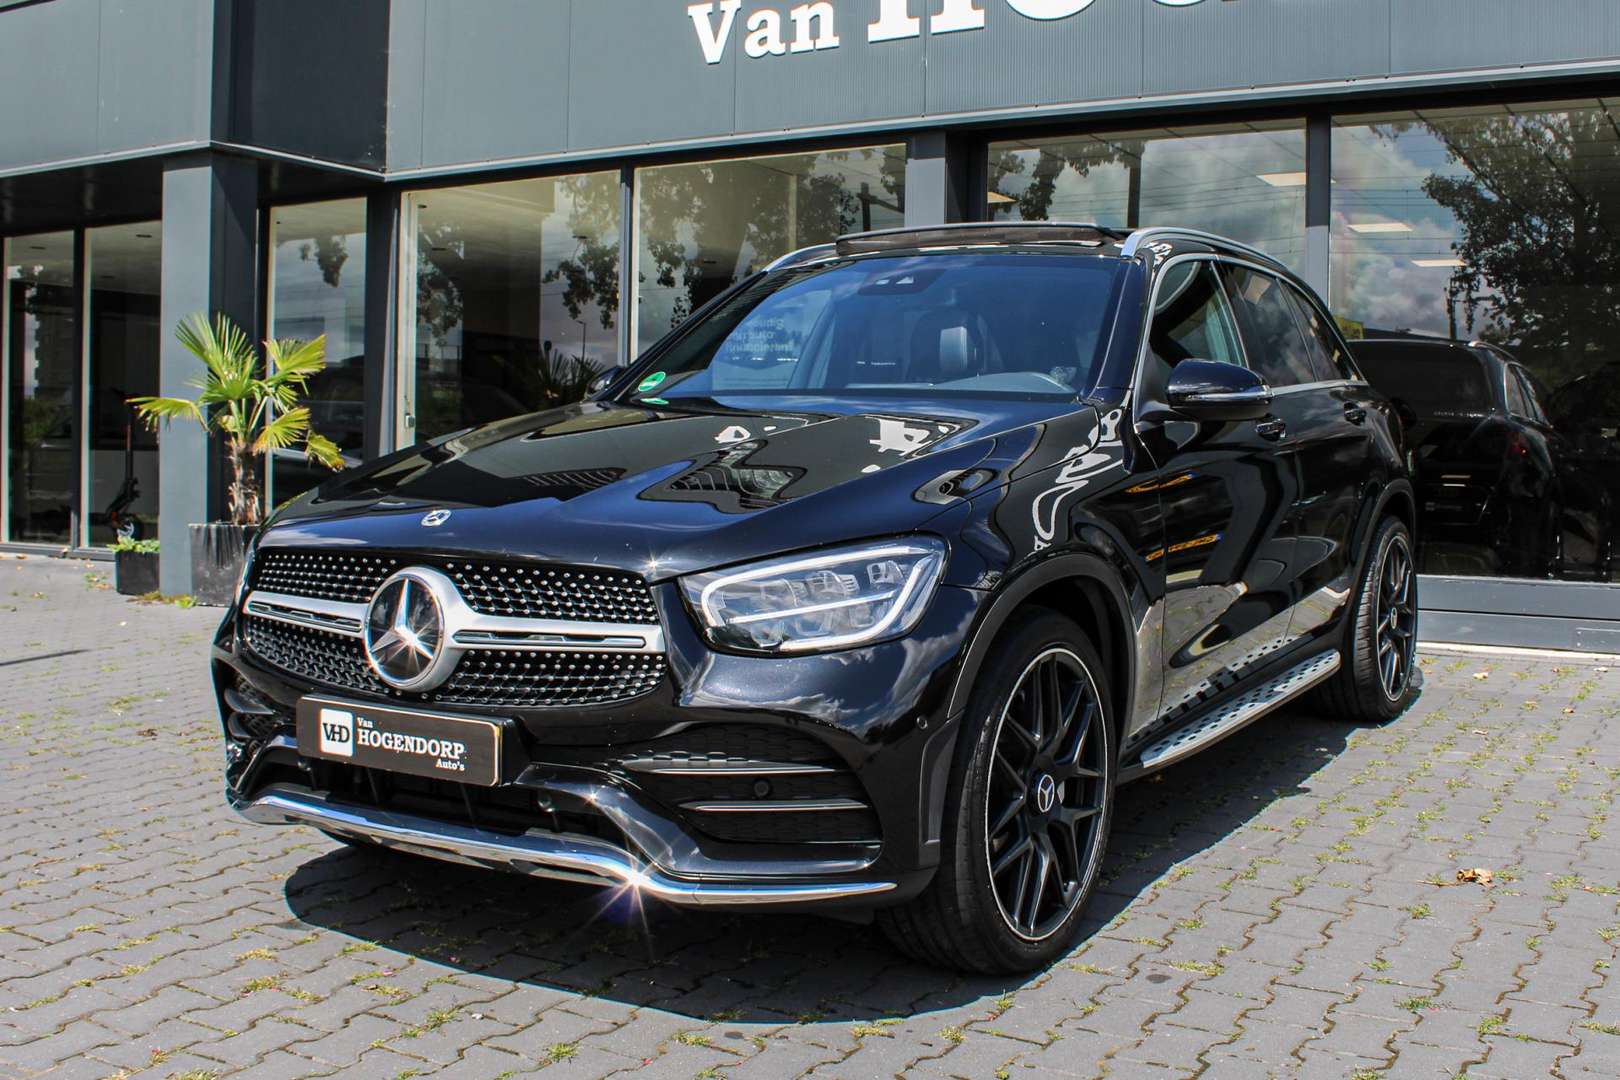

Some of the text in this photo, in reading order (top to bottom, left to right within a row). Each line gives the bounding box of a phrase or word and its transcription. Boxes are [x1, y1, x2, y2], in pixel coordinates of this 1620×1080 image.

[687, 0, 840, 64] Van
[322, 722, 350, 743] VHD
[357, 716, 373, 728] Van
[357, 728, 465, 760] HOGENDORP
[435, 758, 465, 771] Auto's
